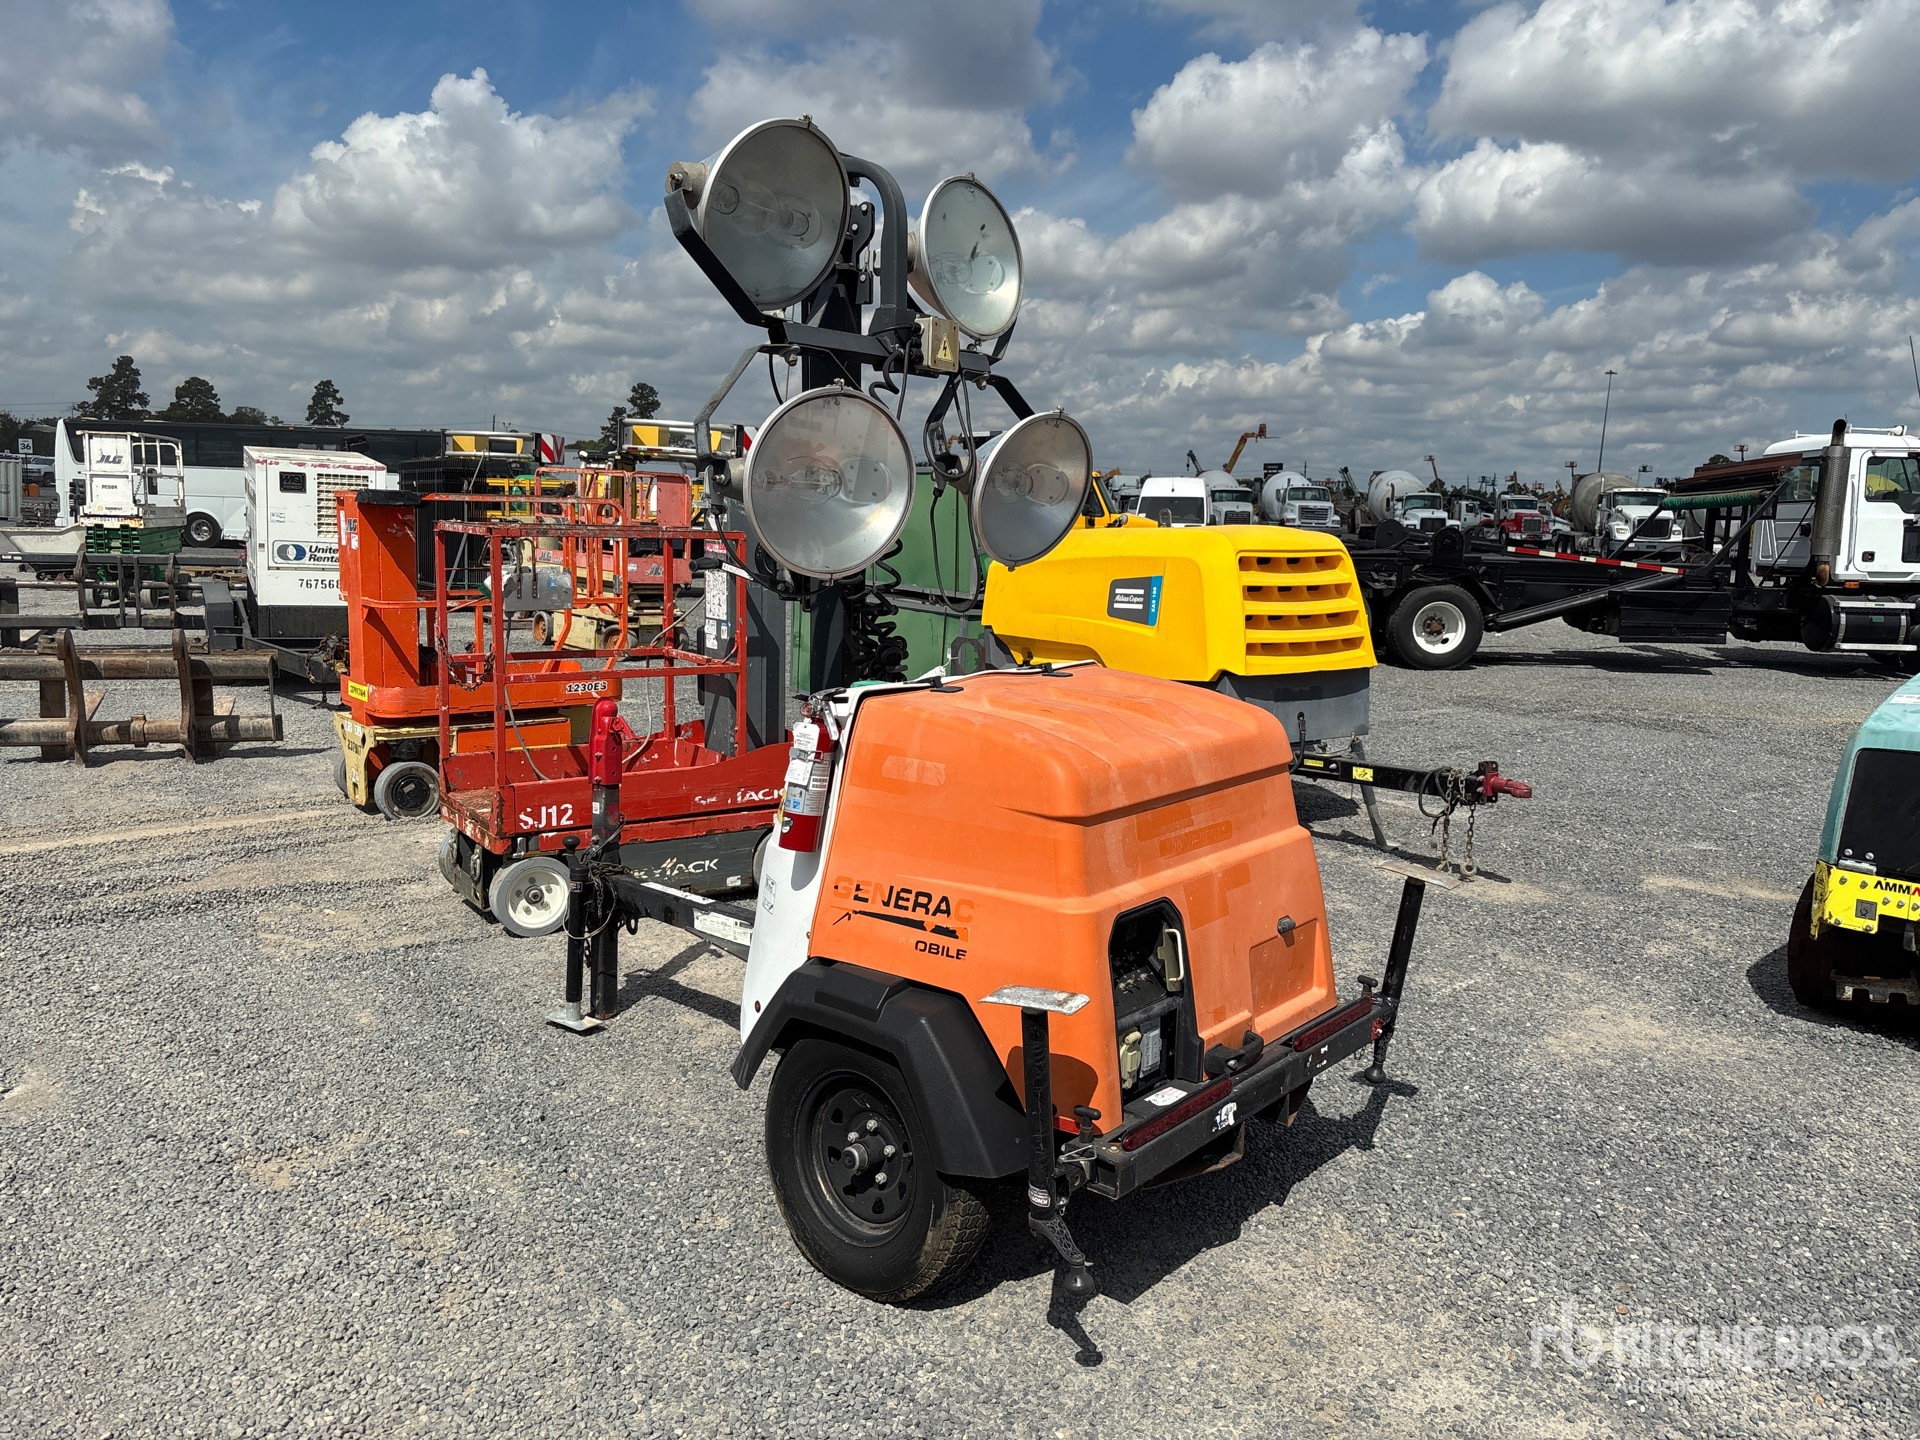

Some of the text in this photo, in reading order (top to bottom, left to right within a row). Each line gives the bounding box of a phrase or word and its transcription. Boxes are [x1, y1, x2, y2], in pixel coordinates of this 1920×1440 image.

[20, 443, 32, 451] 36
[96, 455, 123, 465] JLG
[283, 474, 303, 484] MQ
[308, 545, 340, 554] Unite
[539, 550, 552, 562] JLG
[566, 682, 608, 693] 1230ES
[519, 803, 574, 830] SJ12
[833, 876, 975, 924] GENERAC
[910, 938, 968, 961] OBILE
